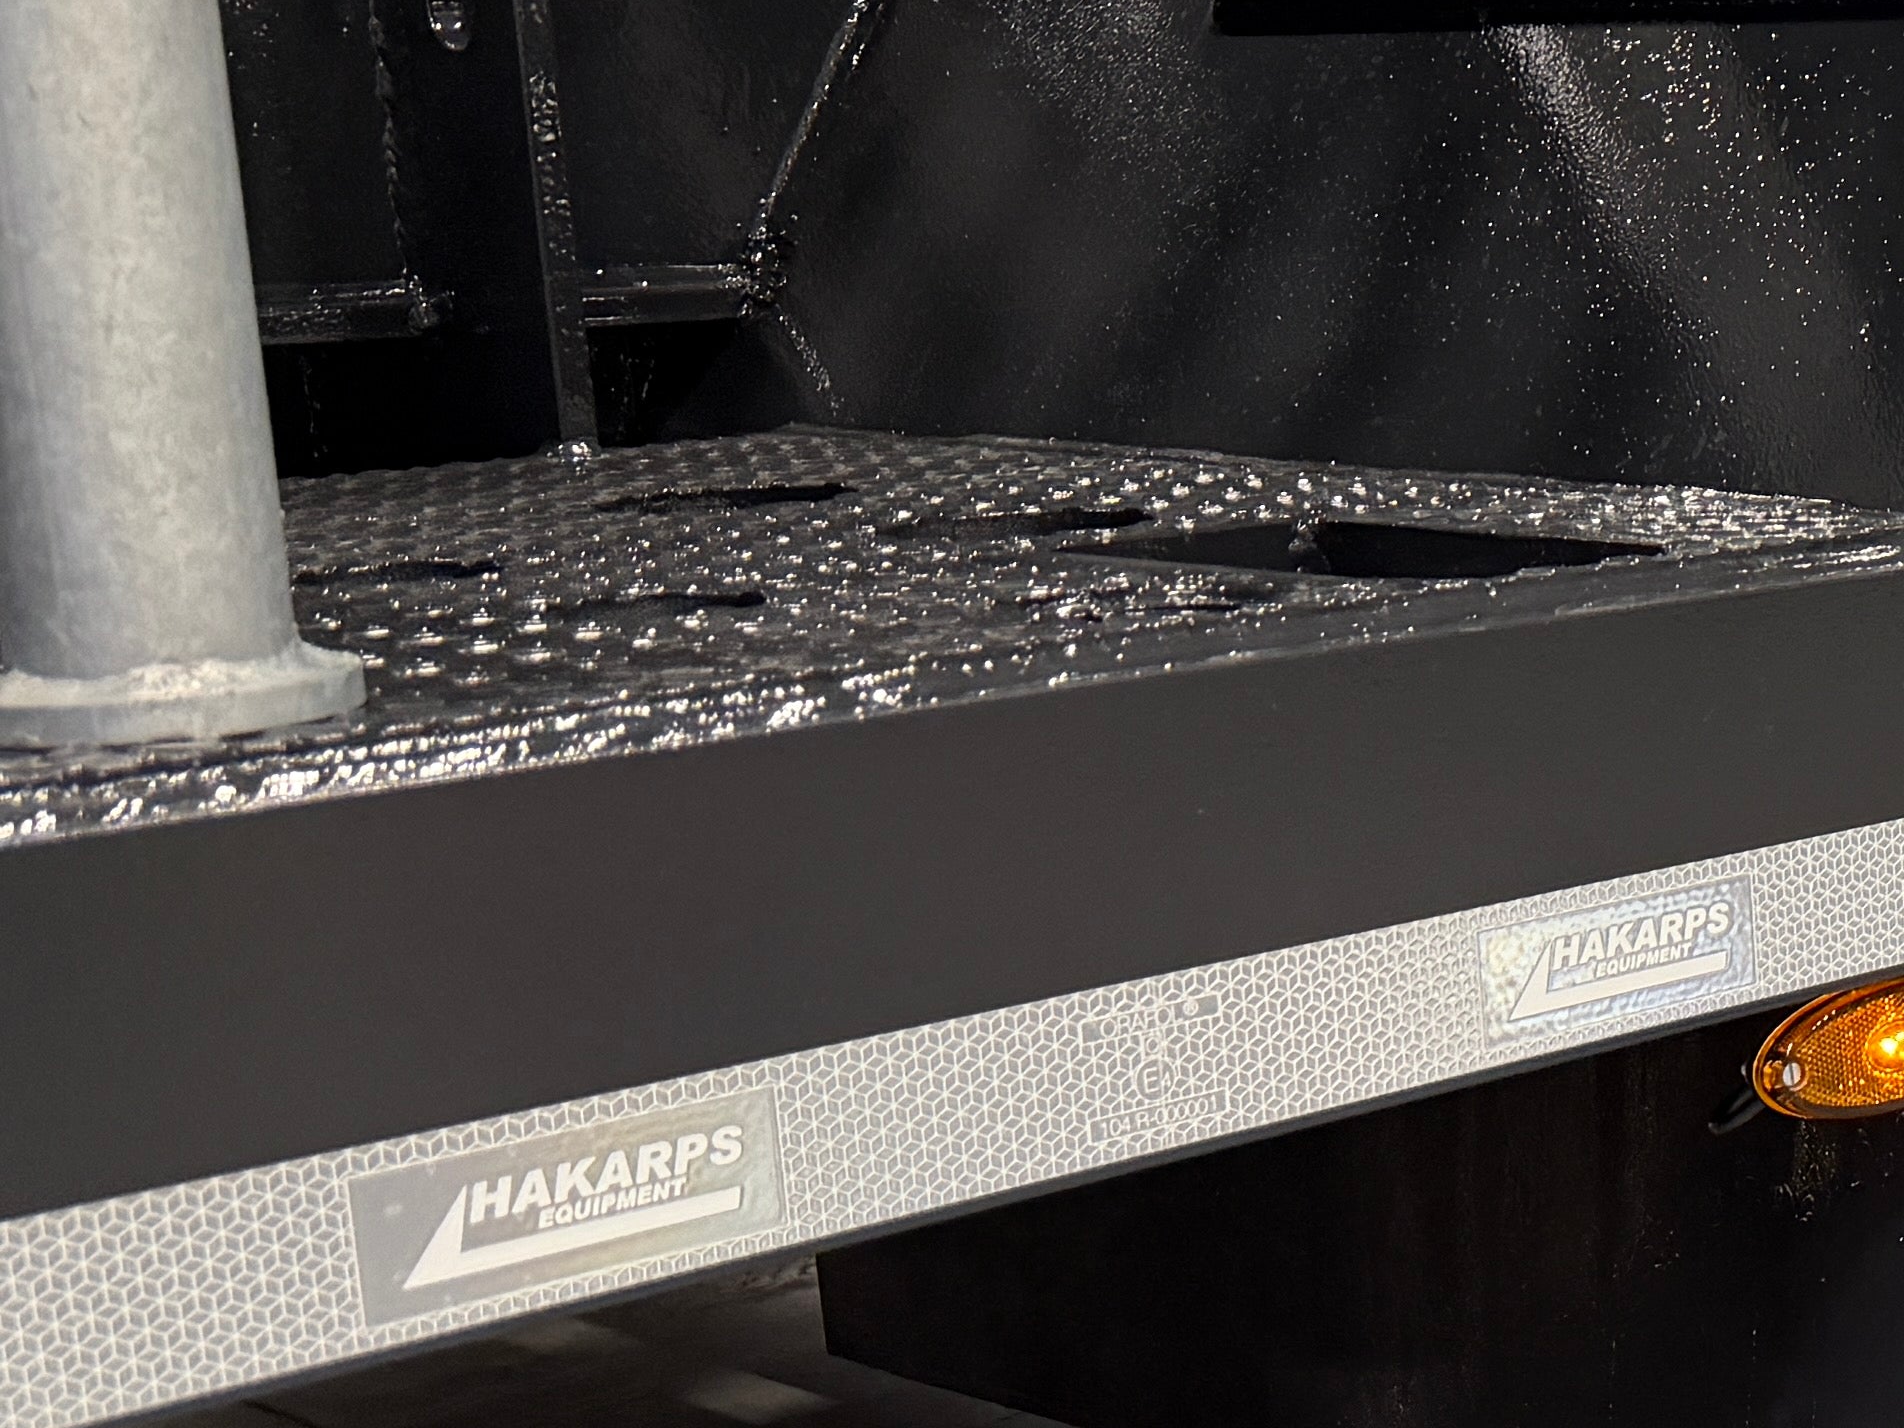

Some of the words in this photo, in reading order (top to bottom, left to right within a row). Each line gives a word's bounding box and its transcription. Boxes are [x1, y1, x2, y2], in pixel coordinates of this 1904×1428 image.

[1552, 900, 1730, 972] HAKARPS
[1595, 941, 1694, 978] EQUIPMENT
[1101, 1115, 1132, 1138] 104
[1135, 1094, 1218, 1130] R-000001
[469, 1124, 743, 1225] HAKARPS
[538, 1175, 689, 1230] EQUIPMENT
